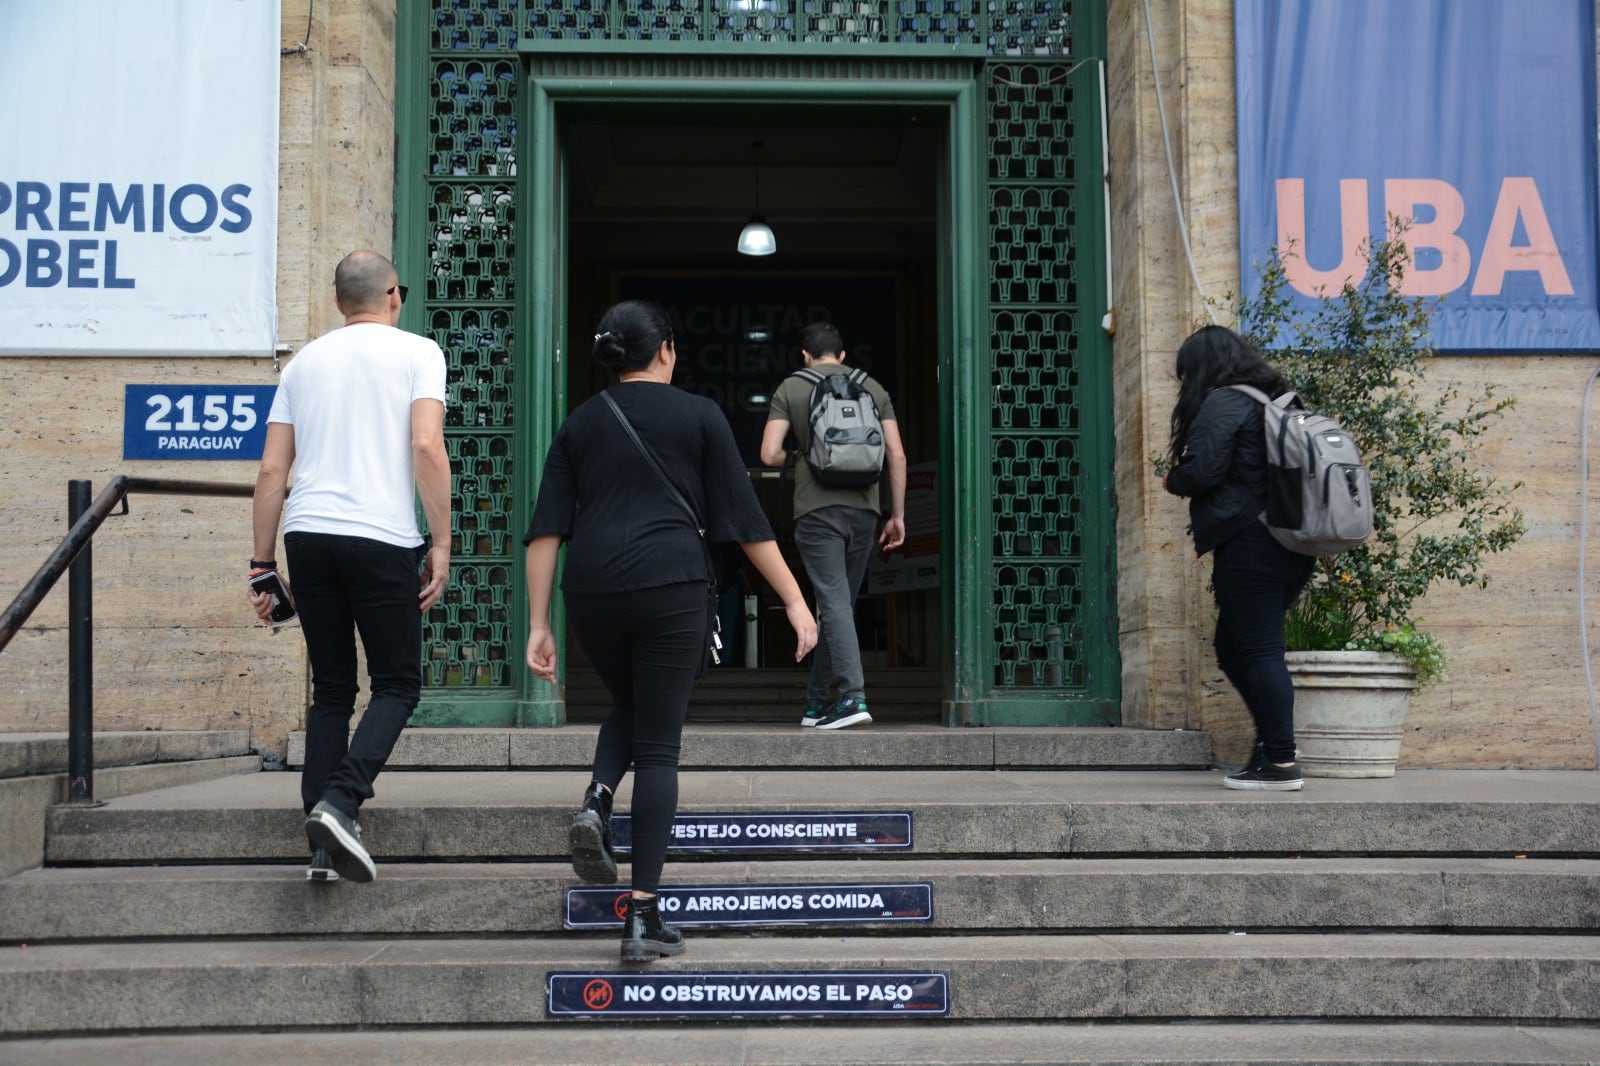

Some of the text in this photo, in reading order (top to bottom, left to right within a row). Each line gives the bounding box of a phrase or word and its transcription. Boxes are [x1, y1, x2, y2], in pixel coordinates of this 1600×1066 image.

[1276, 177, 1575, 299] UBA
[669, 303, 833, 335] ACULTAD
[145, 394, 257, 432] 2155
[158, 436, 244, 450] PARAGUAY
[670, 823, 856, 838] ESTEJO CONSCIENTE
[685, 895, 803, 911] ARROJEMOS
[807, 894, 884, 909] COMIDA
[623, 985, 913, 1001] NO OBSTRUYAMOS EL PASO
